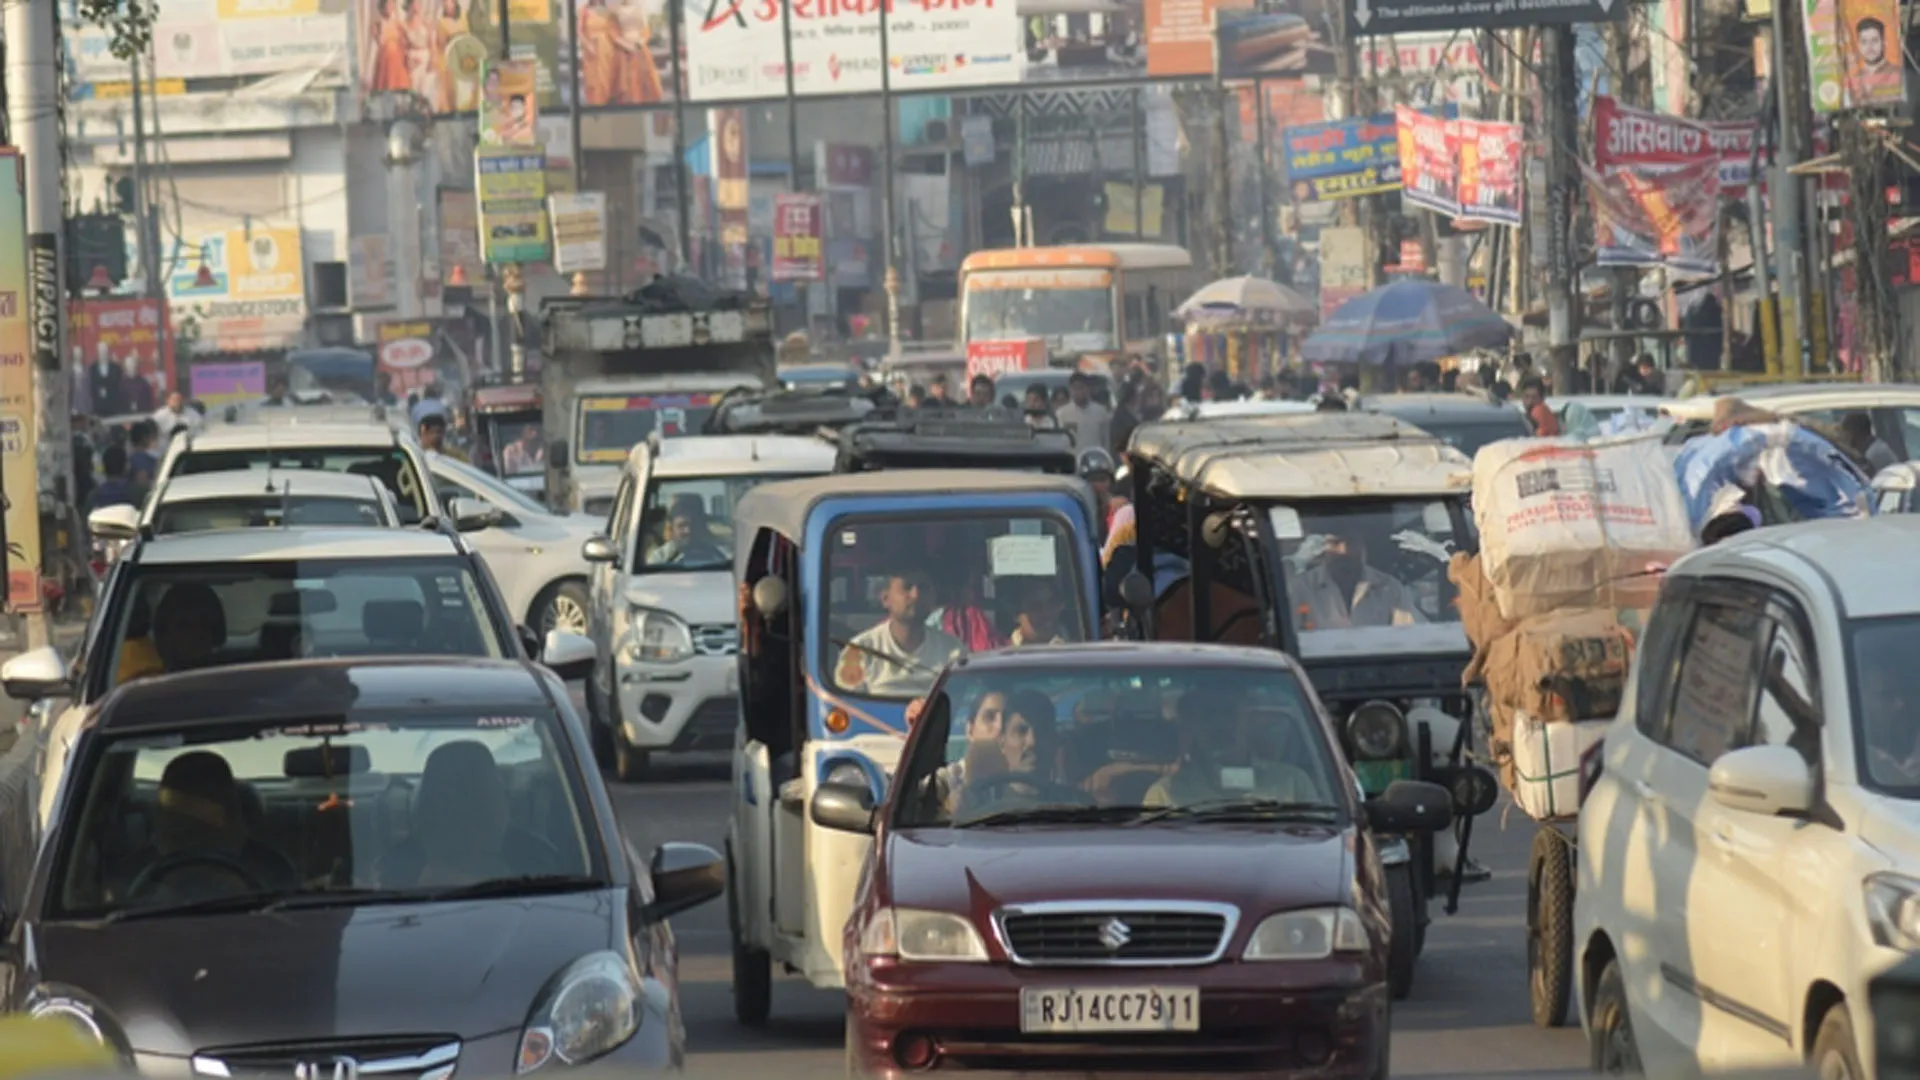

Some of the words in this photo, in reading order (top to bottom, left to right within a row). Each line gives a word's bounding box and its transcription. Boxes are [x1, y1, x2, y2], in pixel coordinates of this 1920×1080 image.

[1376, 5, 1399, 19] The
[1402, 3, 1455, 18] ultimate
[1457, 1, 1491, 13] silver
[35, 248, 58, 358] IMPACT
[970, 355, 1024, 376] OSWAL
[1041, 993, 1193, 1024] RJ14CC7911
